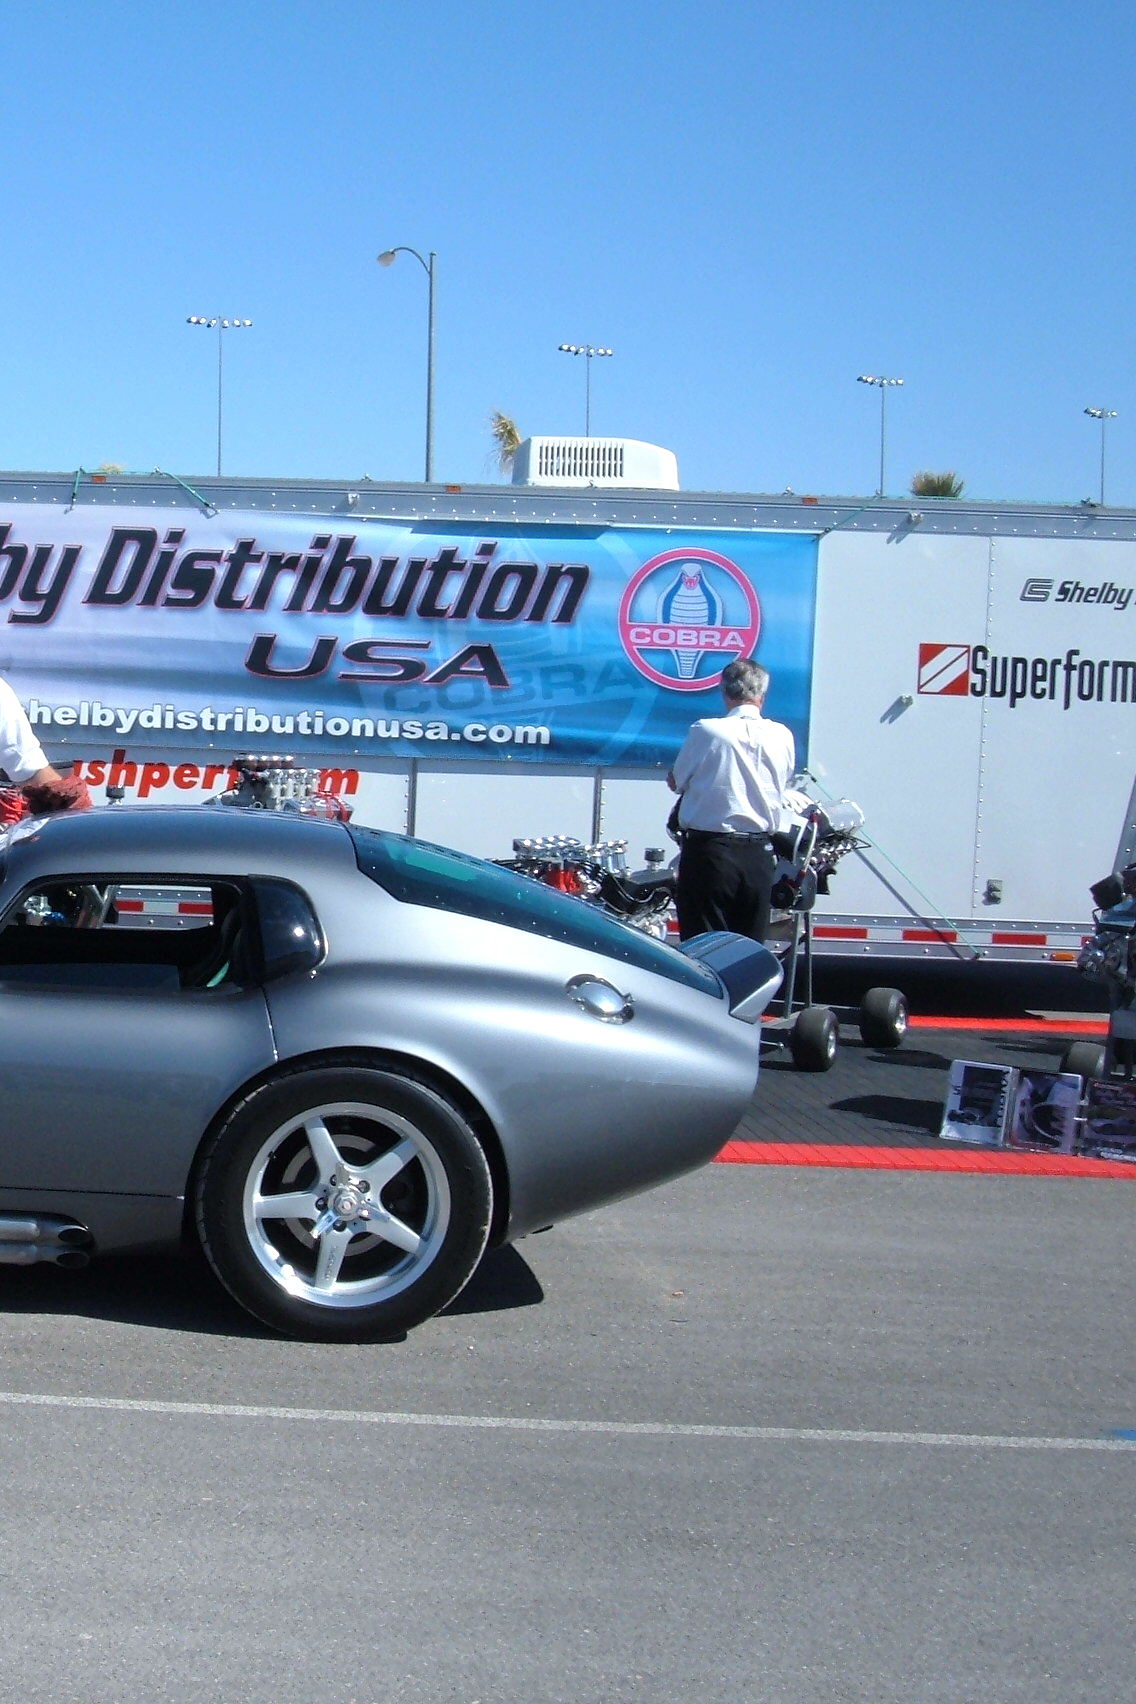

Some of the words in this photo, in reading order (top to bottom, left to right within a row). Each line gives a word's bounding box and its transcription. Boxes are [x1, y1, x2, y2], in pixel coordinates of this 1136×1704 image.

[81, 525, 591, 624] Distribution
[1055, 581, 1134, 610] Shelby
[244, 632, 512, 689] USA
[629, 628, 746, 648] COBRA
[28, 698, 552, 745] helbydistributionusa.com
